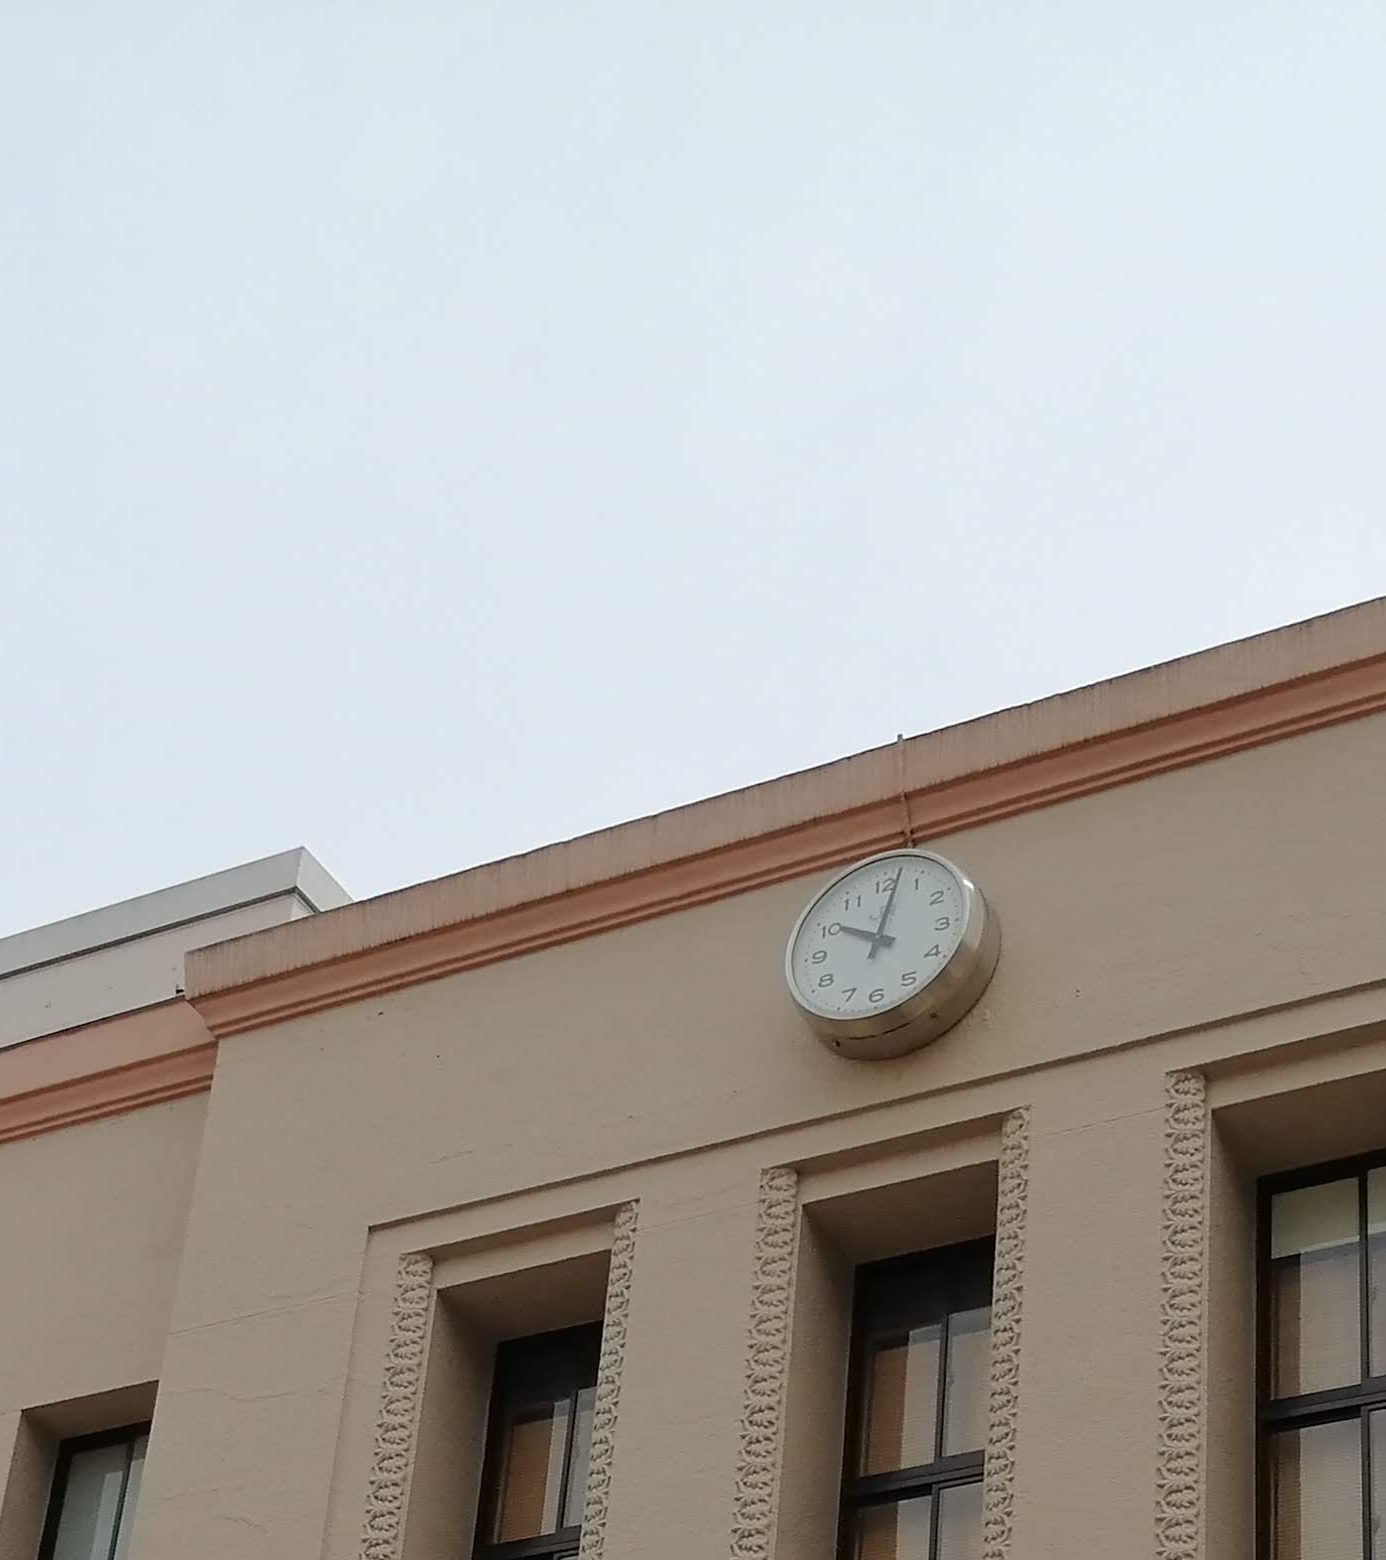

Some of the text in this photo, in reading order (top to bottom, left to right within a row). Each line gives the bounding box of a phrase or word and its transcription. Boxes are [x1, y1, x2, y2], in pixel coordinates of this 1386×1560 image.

[875, 878, 896, 894] 12
[914, 878, 919, 891] 1
[844, 895, 862, 911] 11
[929, 890, 944, 906] 2
[821, 923, 842, 938] 10
[934, 917, 950, 931] 3
[811, 950, 827, 965] 9
[923, 944, 941, 959] 4
[818, 973, 834, 988] 8
[901, 971, 917, 987] 5
[841, 988, 857, 1003] 7
[868, 989, 885, 1003] 6
